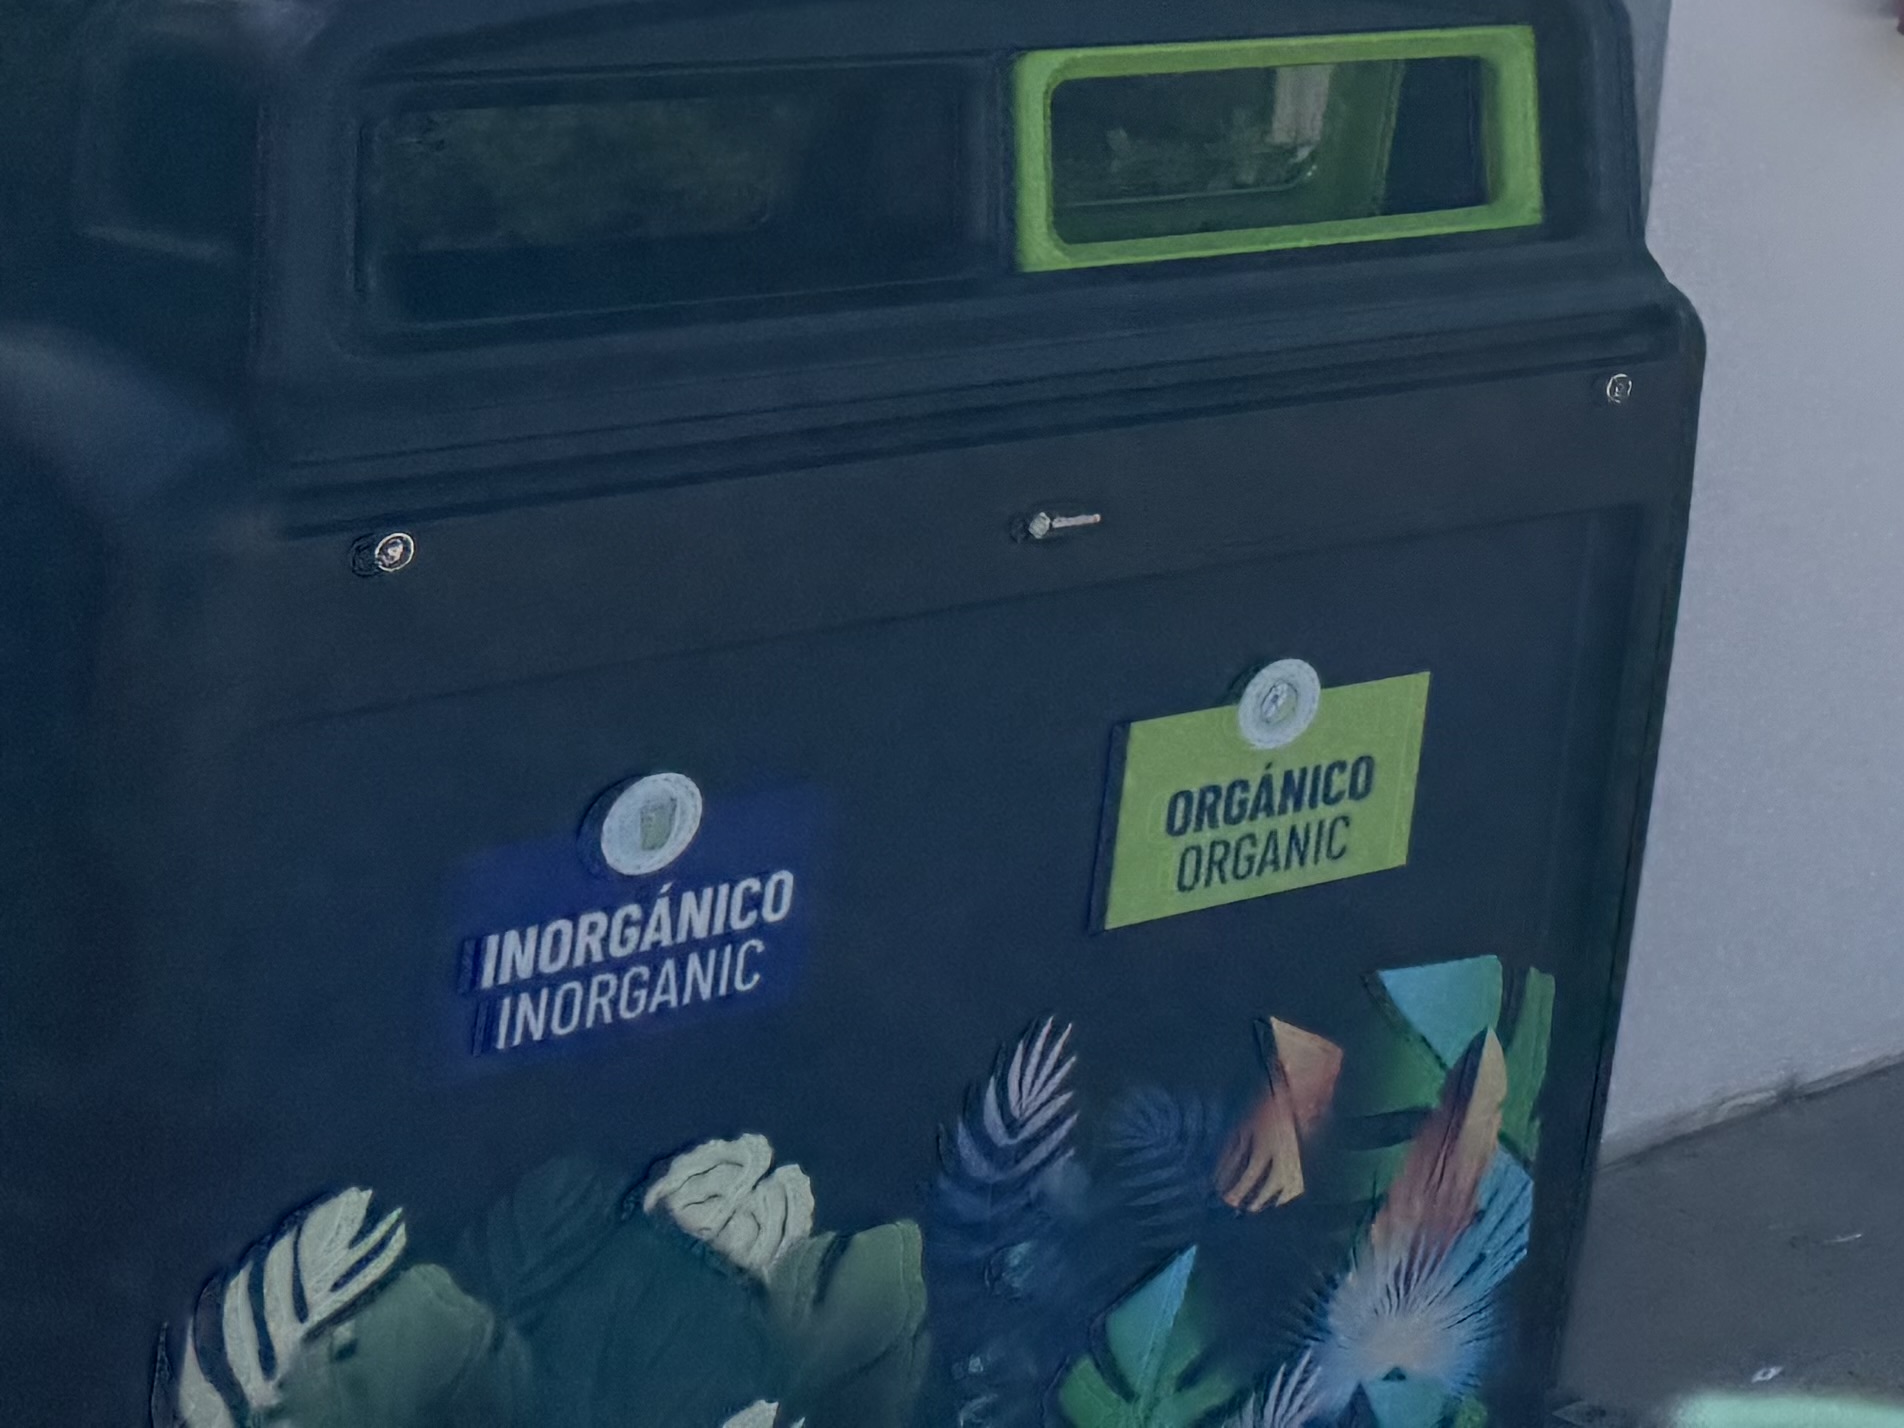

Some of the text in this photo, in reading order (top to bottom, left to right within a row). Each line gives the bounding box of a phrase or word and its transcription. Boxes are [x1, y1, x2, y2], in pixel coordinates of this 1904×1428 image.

[1166, 755, 1375, 837] ORGÁNICO
[1177, 815, 1350, 892] ORGANIC
[481, 870, 794, 990] INORGÁNICO
[496, 939, 764, 1049] INORGANIC
